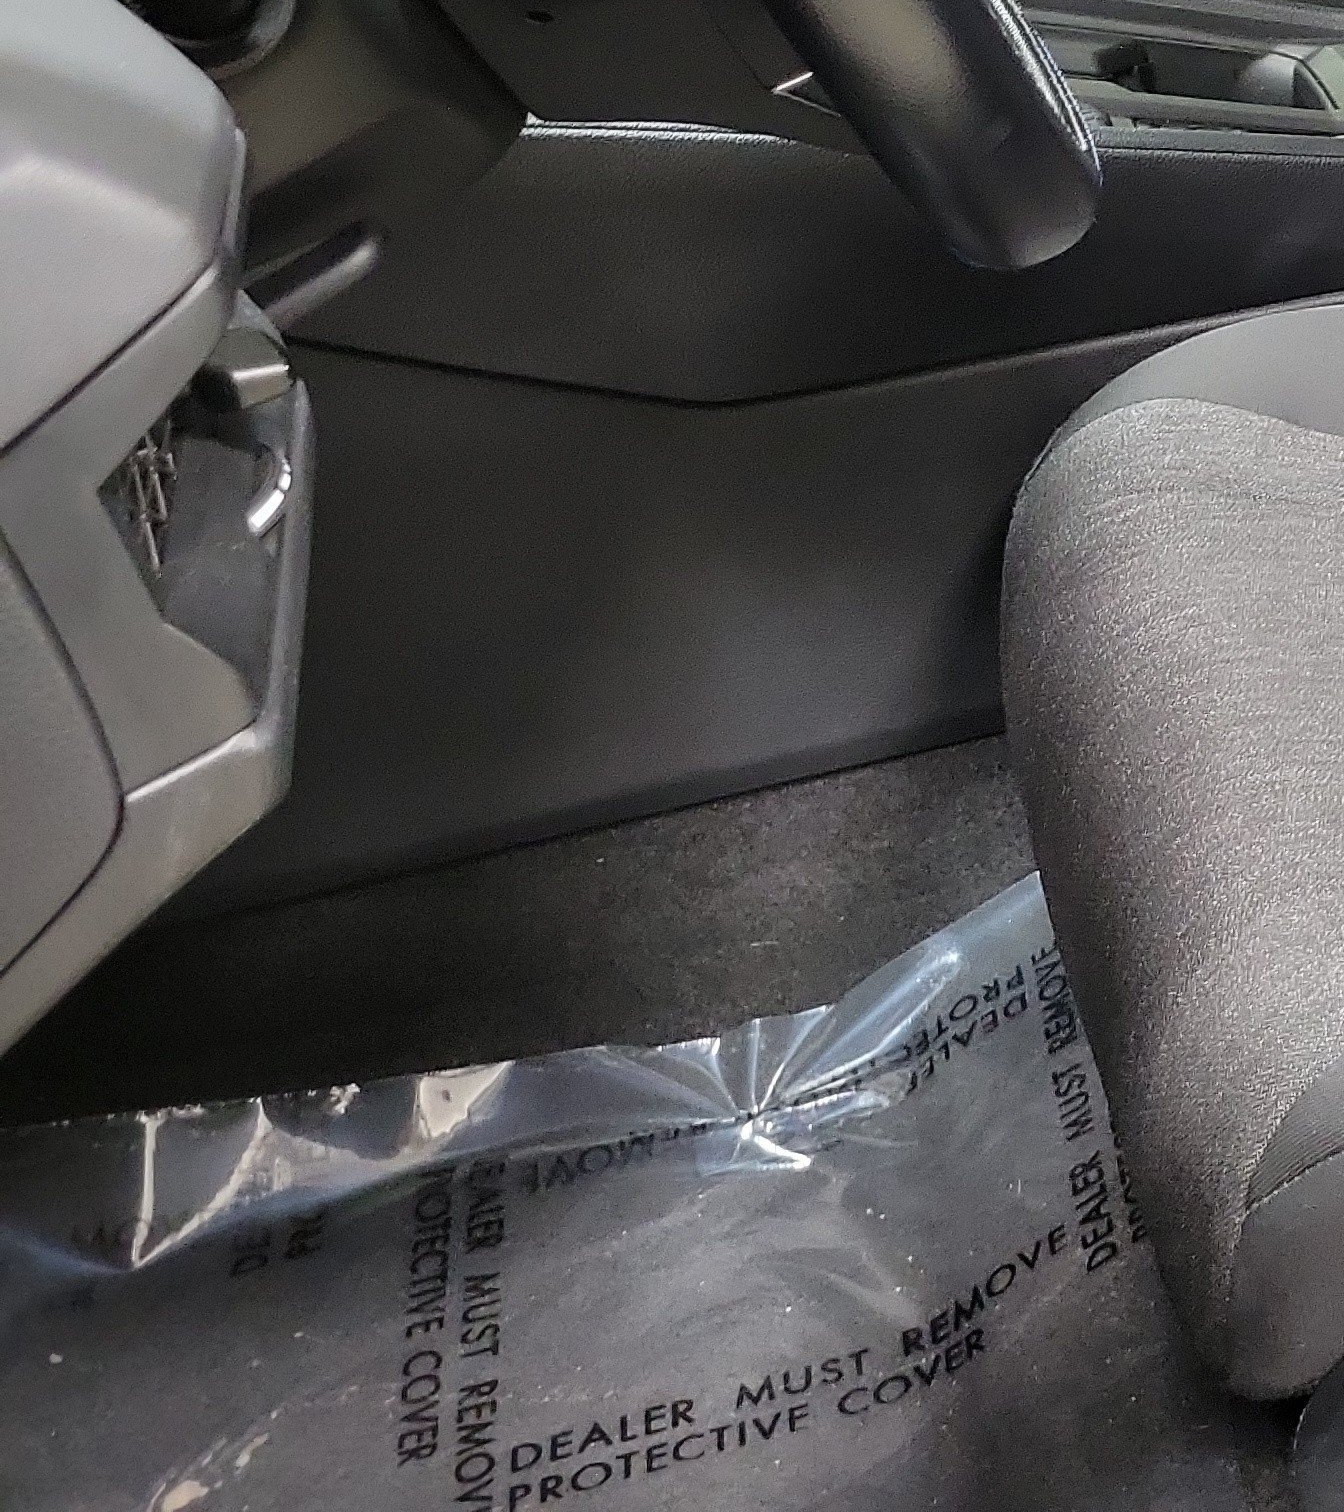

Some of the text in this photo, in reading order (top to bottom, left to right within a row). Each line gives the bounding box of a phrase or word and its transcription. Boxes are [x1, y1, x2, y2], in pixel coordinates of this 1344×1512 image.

[1030, 946, 1118, 1274] DEALER MUST REMOVE
[459, 1271, 502, 1360] MUST
[509, 1223, 1067, 1474] DEALER MUST REMOVE
[397, 1349, 444, 1469] COVER
[450, 1378, 500, 1512] REMOV
[507, 1327, 986, 1512] PROTECTIVE COVER
